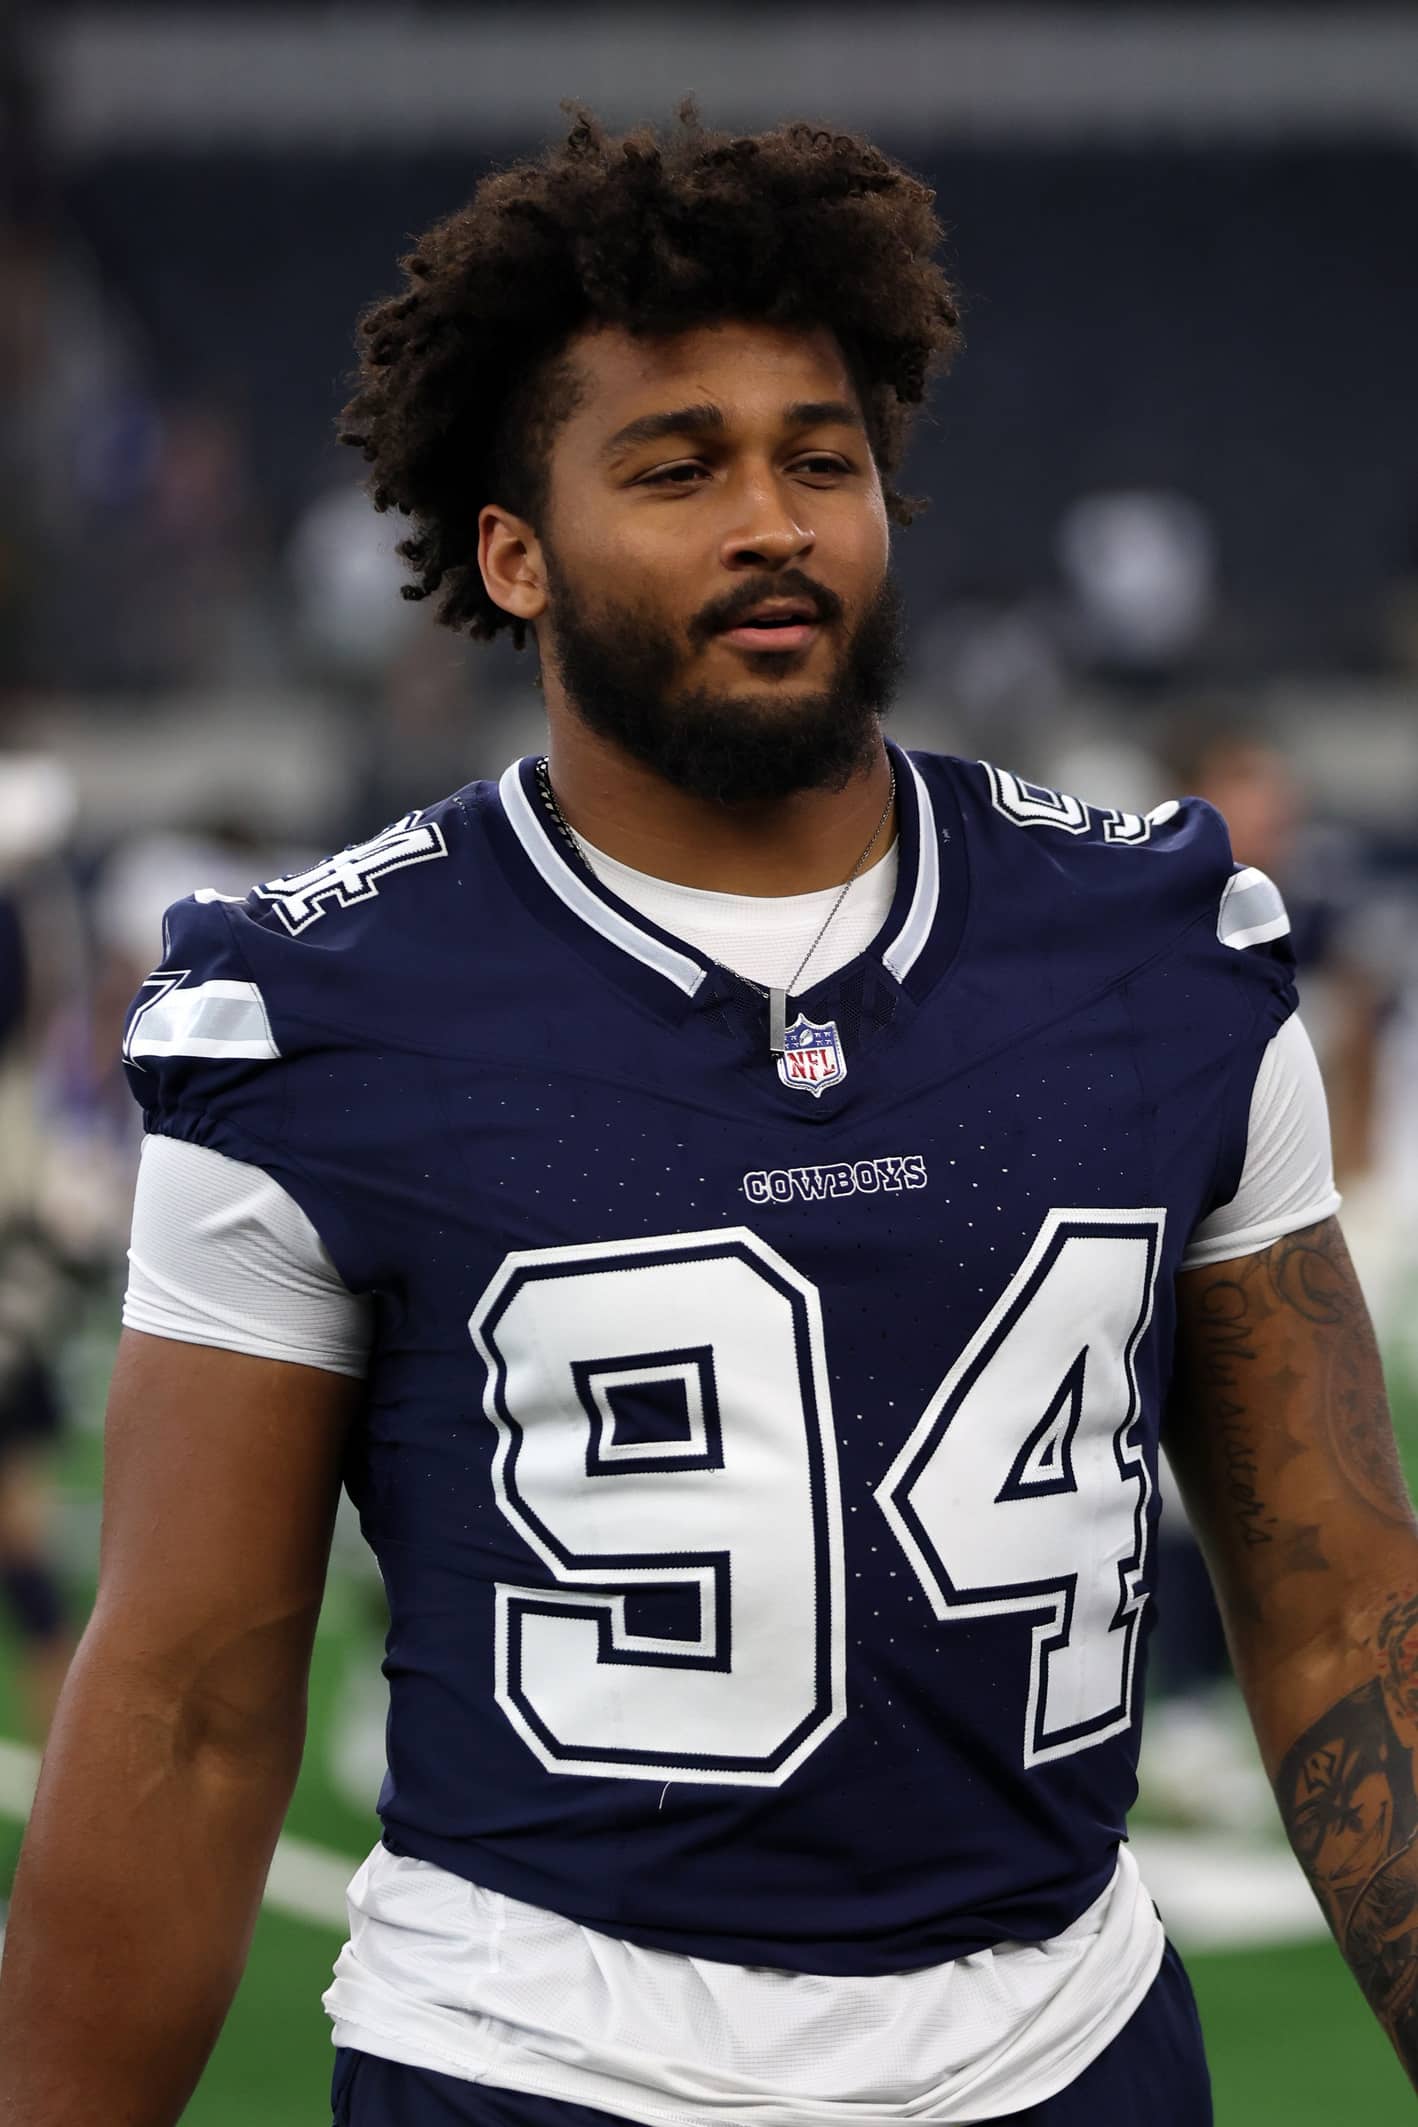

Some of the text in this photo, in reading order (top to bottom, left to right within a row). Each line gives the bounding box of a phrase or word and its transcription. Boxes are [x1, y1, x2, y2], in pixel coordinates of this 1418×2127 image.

[787, 1049, 836, 1081] NFL
[744, 1155, 928, 1204] COWBOYS
[468, 1207, 1167, 1788] 94
